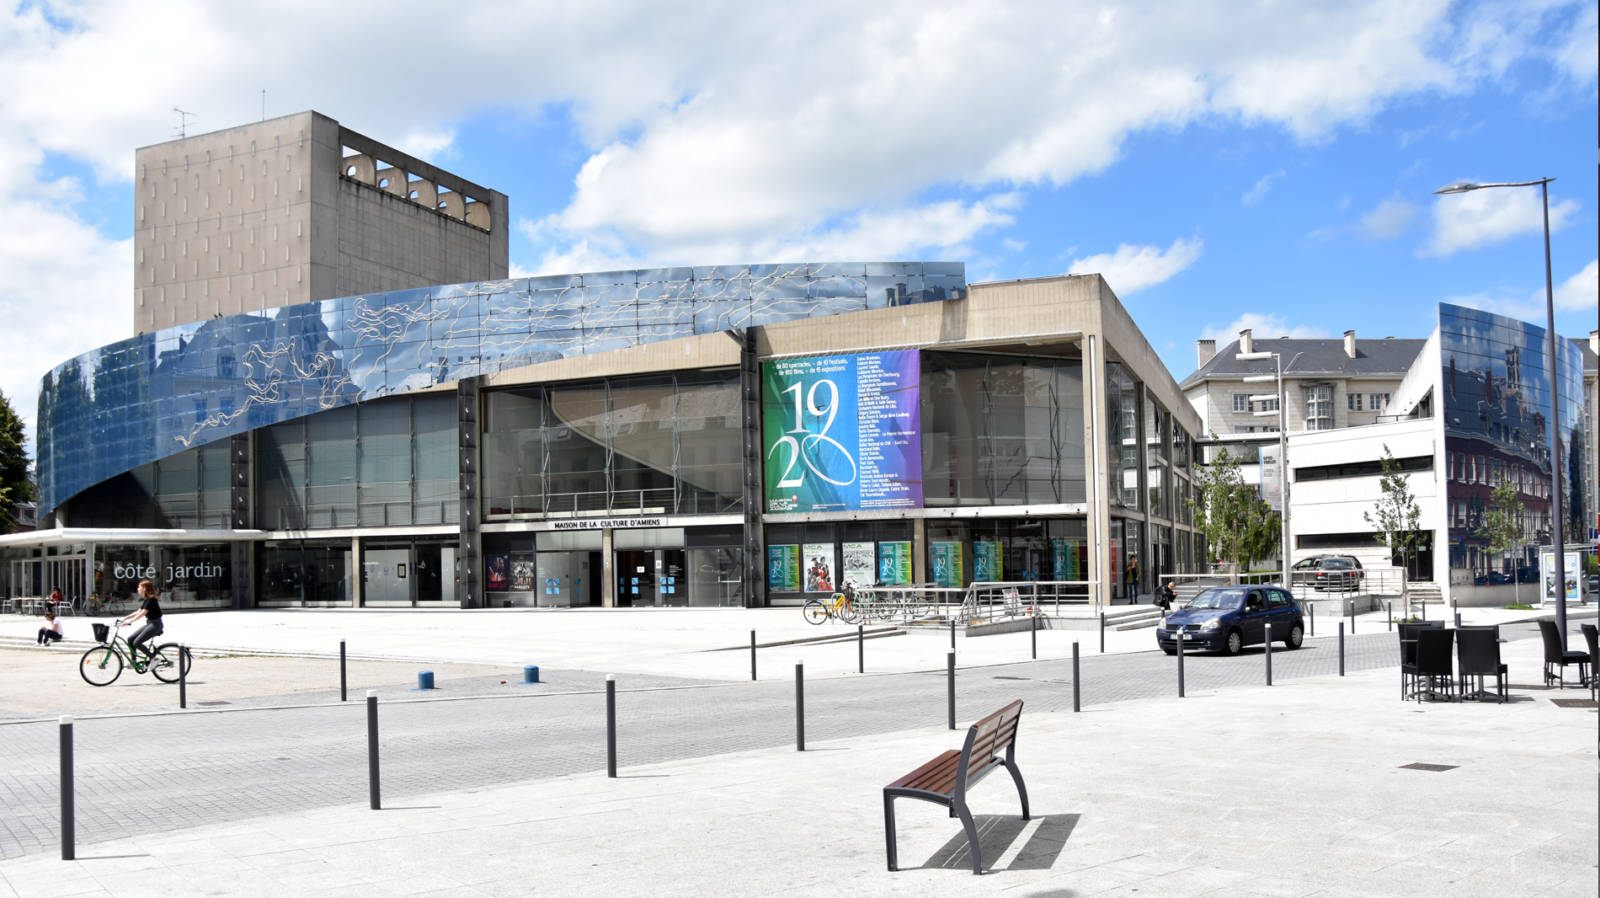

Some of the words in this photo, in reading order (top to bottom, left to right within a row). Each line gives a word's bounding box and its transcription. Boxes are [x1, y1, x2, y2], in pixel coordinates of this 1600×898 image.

[781, 379, 839, 449] 19
[768, 434, 857, 489] 20
[579, 520, 588, 528] DE
[600, 519, 628, 527] CULTURE
[630, 518, 660, 526] D'AMIENS
[114, 563, 156, 579] côté
[166, 562, 222, 583] jardin
